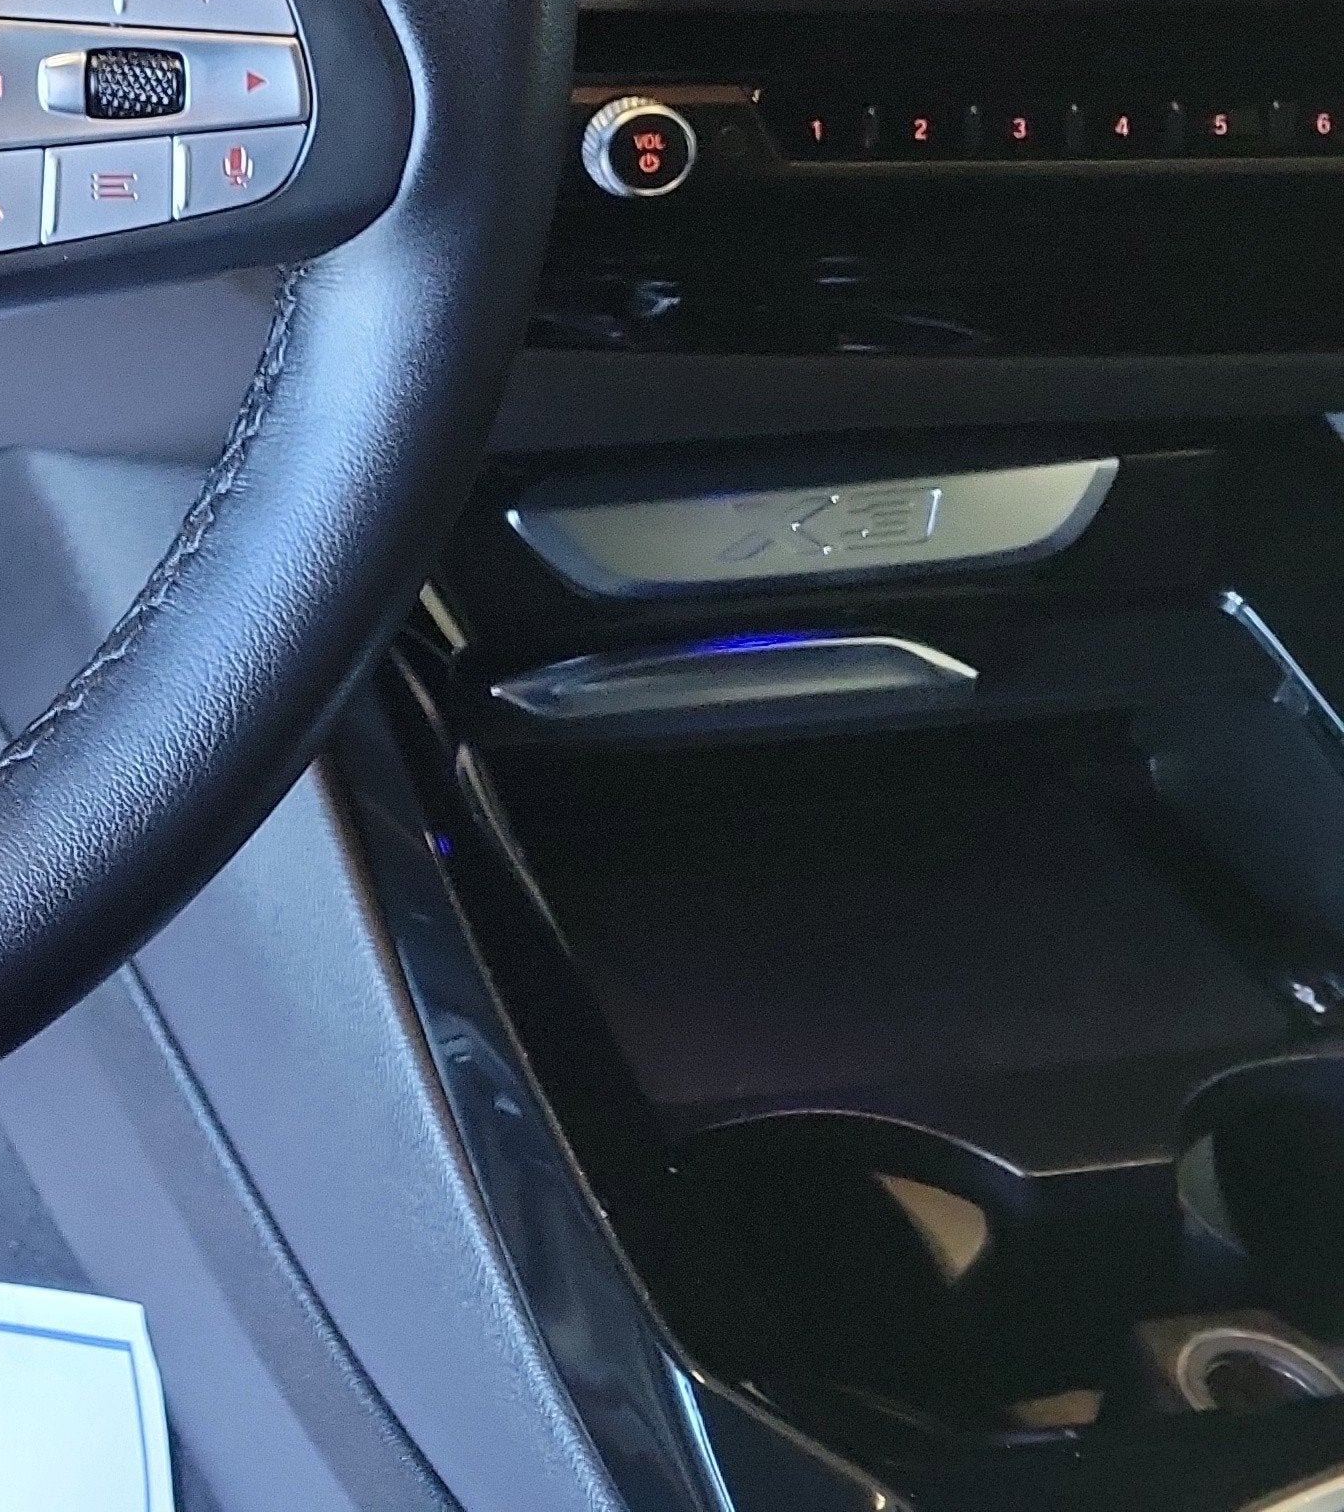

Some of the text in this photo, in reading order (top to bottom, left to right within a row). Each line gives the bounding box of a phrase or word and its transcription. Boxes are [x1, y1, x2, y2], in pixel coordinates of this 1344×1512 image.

[811, 119, 824, 141] 1
[914, 118, 928, 140] 2
[1013, 117, 1028, 139] 3
[1115, 115, 1130, 136] 4
[1213, 114, 1229, 135] 5
[1316, 113, 1331, 135] 6
[633, 132, 665, 152] VOL
